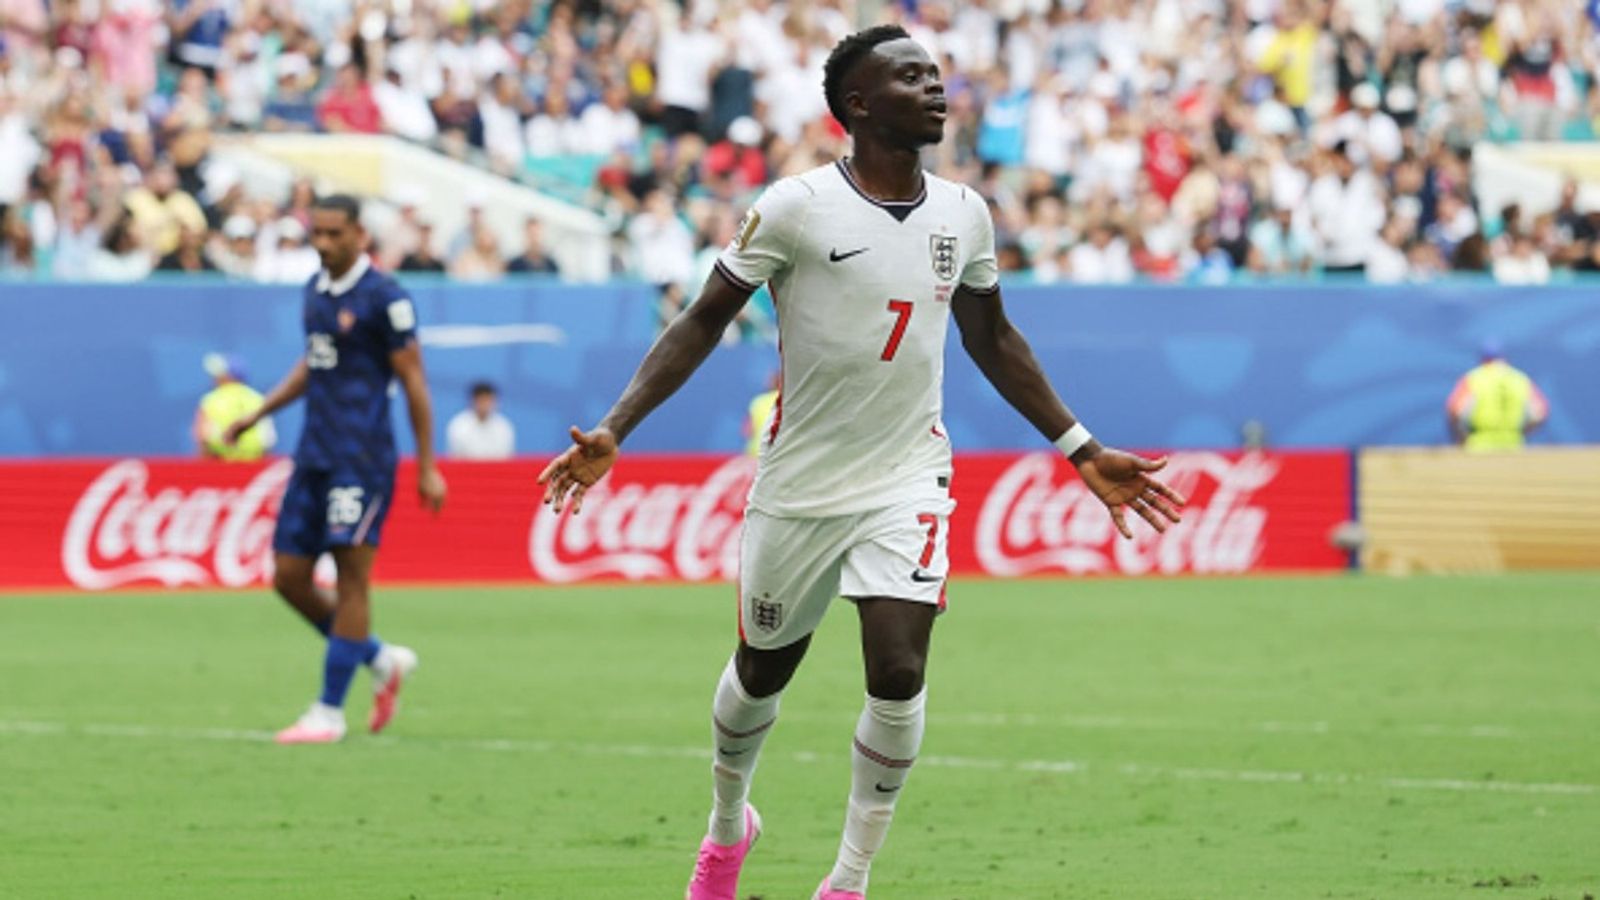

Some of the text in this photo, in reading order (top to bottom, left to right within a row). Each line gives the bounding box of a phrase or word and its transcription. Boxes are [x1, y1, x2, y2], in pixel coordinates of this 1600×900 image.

[879, 299, 914, 362] 7
[916, 512, 938, 569] 7
[975, 447, 1280, 577] CocaCola
